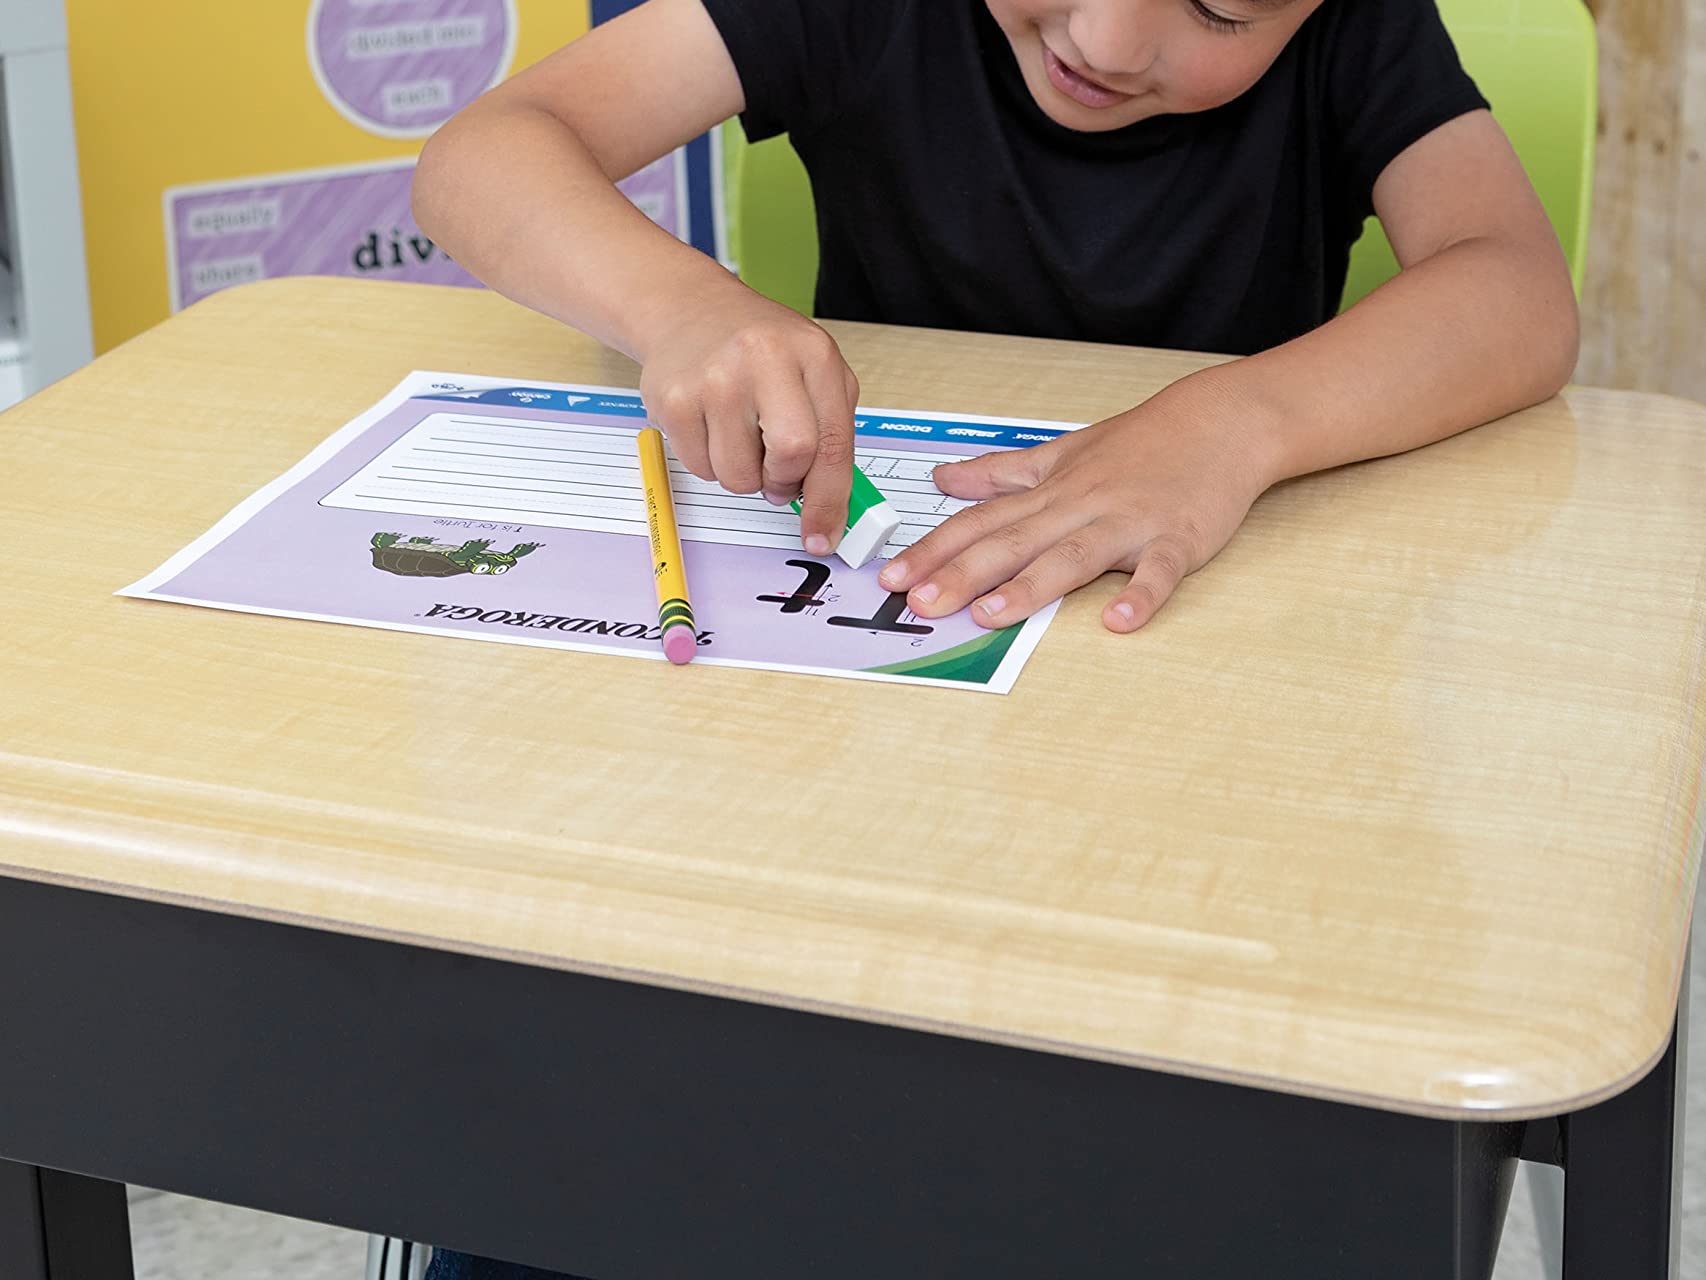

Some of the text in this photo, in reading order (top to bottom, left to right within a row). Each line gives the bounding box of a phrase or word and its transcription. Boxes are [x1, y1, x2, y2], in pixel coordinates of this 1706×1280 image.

[353, 229, 455, 272] div
[881, 423, 934, 434] DIXON
[432, 518, 475, 529] Turtle
[476, 522, 498, 531] for
[425, 603, 715, 646] TCONDEROGA
